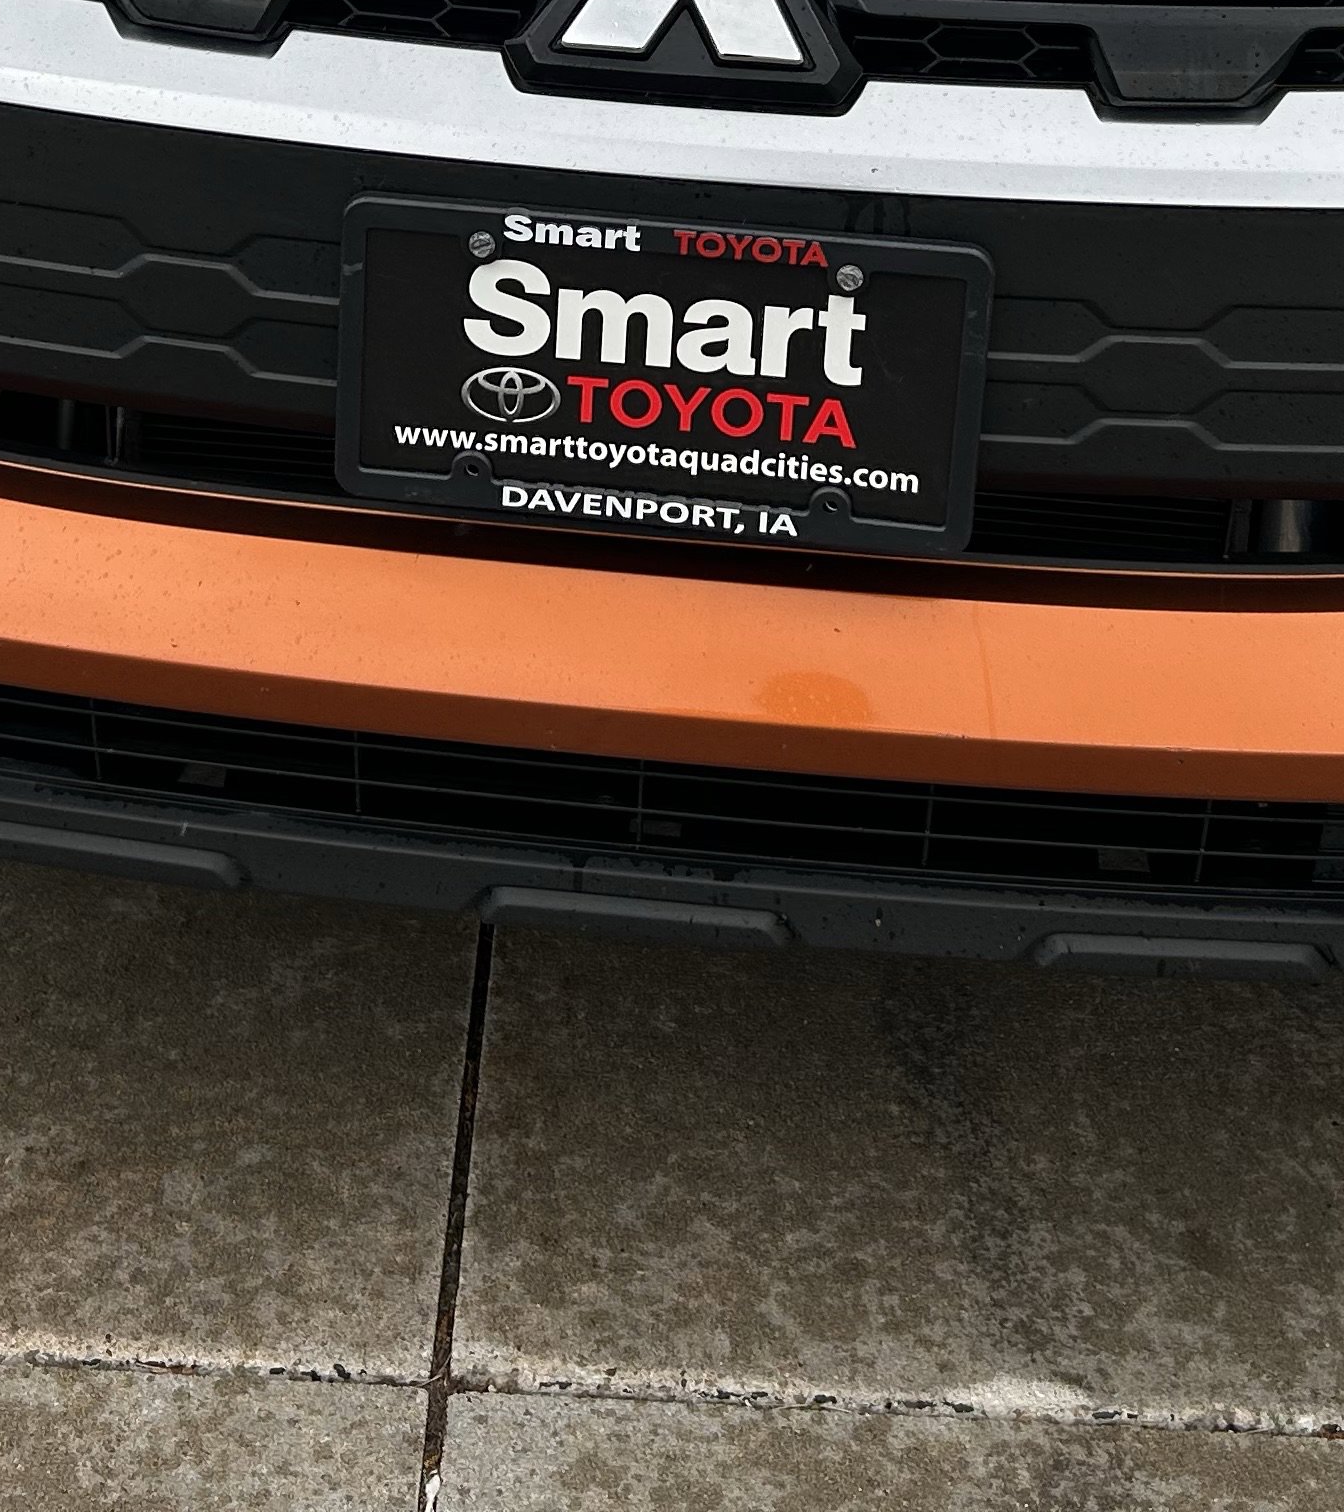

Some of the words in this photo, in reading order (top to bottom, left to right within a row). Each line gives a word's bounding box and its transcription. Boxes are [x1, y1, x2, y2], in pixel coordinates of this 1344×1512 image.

[503, 214, 641, 252] Smart
[673, 230, 829, 268] TOYOTA
[463, 259, 867, 386] Smart
[567, 374, 856, 449] TOYOTA
[394, 425, 919, 494] www.smarttoyotaquadcities.com
[501, 485, 746, 535] DAVENPORT,
[758, 511, 798, 537] IA
